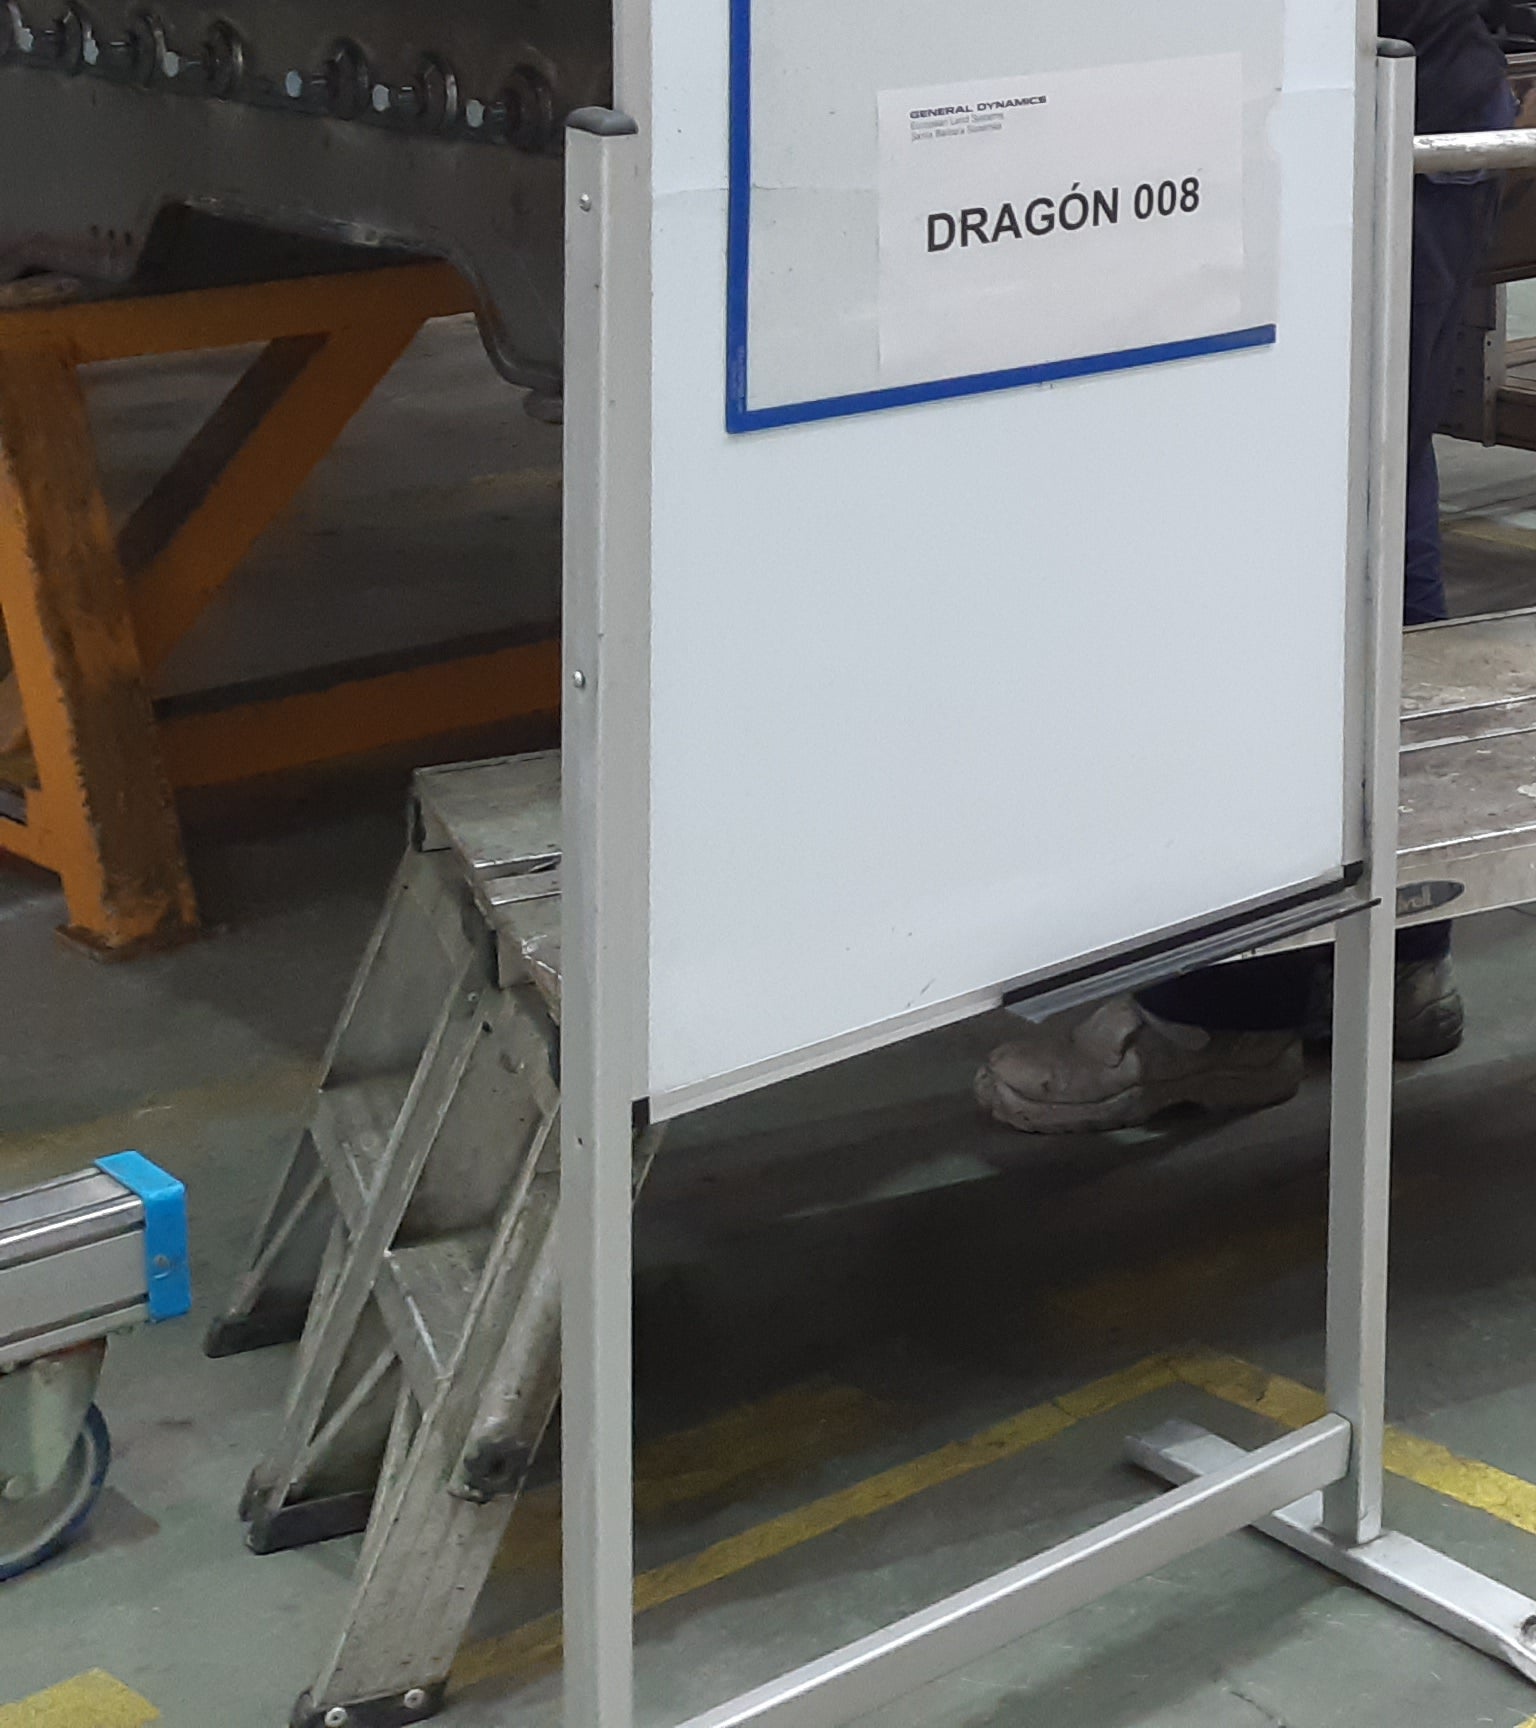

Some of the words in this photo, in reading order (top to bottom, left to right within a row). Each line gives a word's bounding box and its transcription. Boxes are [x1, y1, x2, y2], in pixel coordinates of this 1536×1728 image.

[909, 105, 973, 119] GENERAL
[976, 95, 1047, 112] DYNAMICS
[927, 182, 1119, 252] DRAGÓN
[1133, 176, 1200, 220] 008
